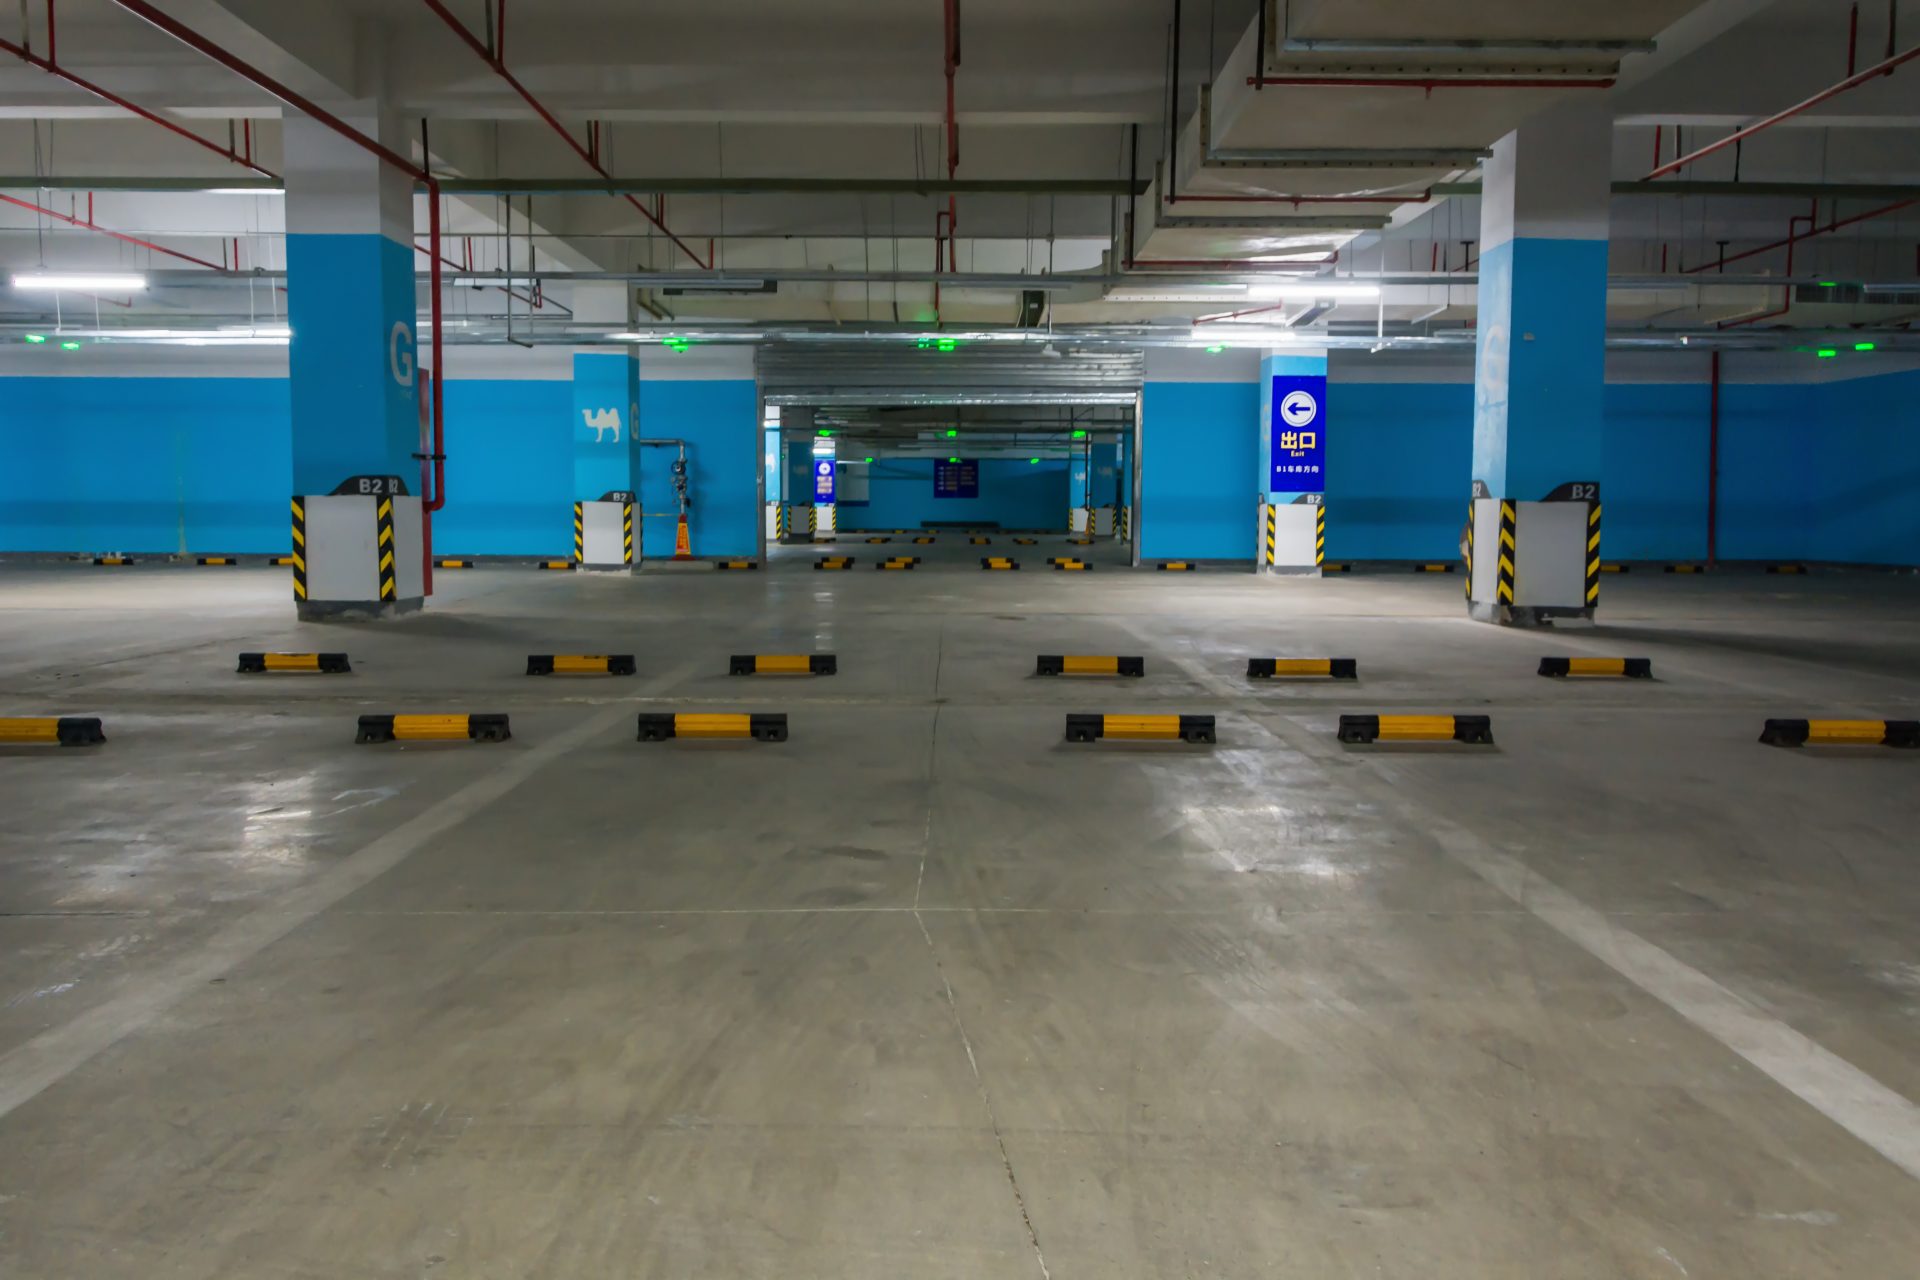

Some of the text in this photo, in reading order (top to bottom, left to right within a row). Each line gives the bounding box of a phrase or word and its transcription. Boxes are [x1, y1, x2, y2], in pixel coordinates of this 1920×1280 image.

[390, 321, 413, 386] G
[1280, 431, 1316, 450] 出口
[1290, 450, 1305, 458] Exit
[359, 478, 383, 493] B2
[388, 478, 399, 493] B2
[1572, 484, 1595, 499] B2
[613, 492, 628, 501] B2
[1307, 494, 1322, 504] B2
